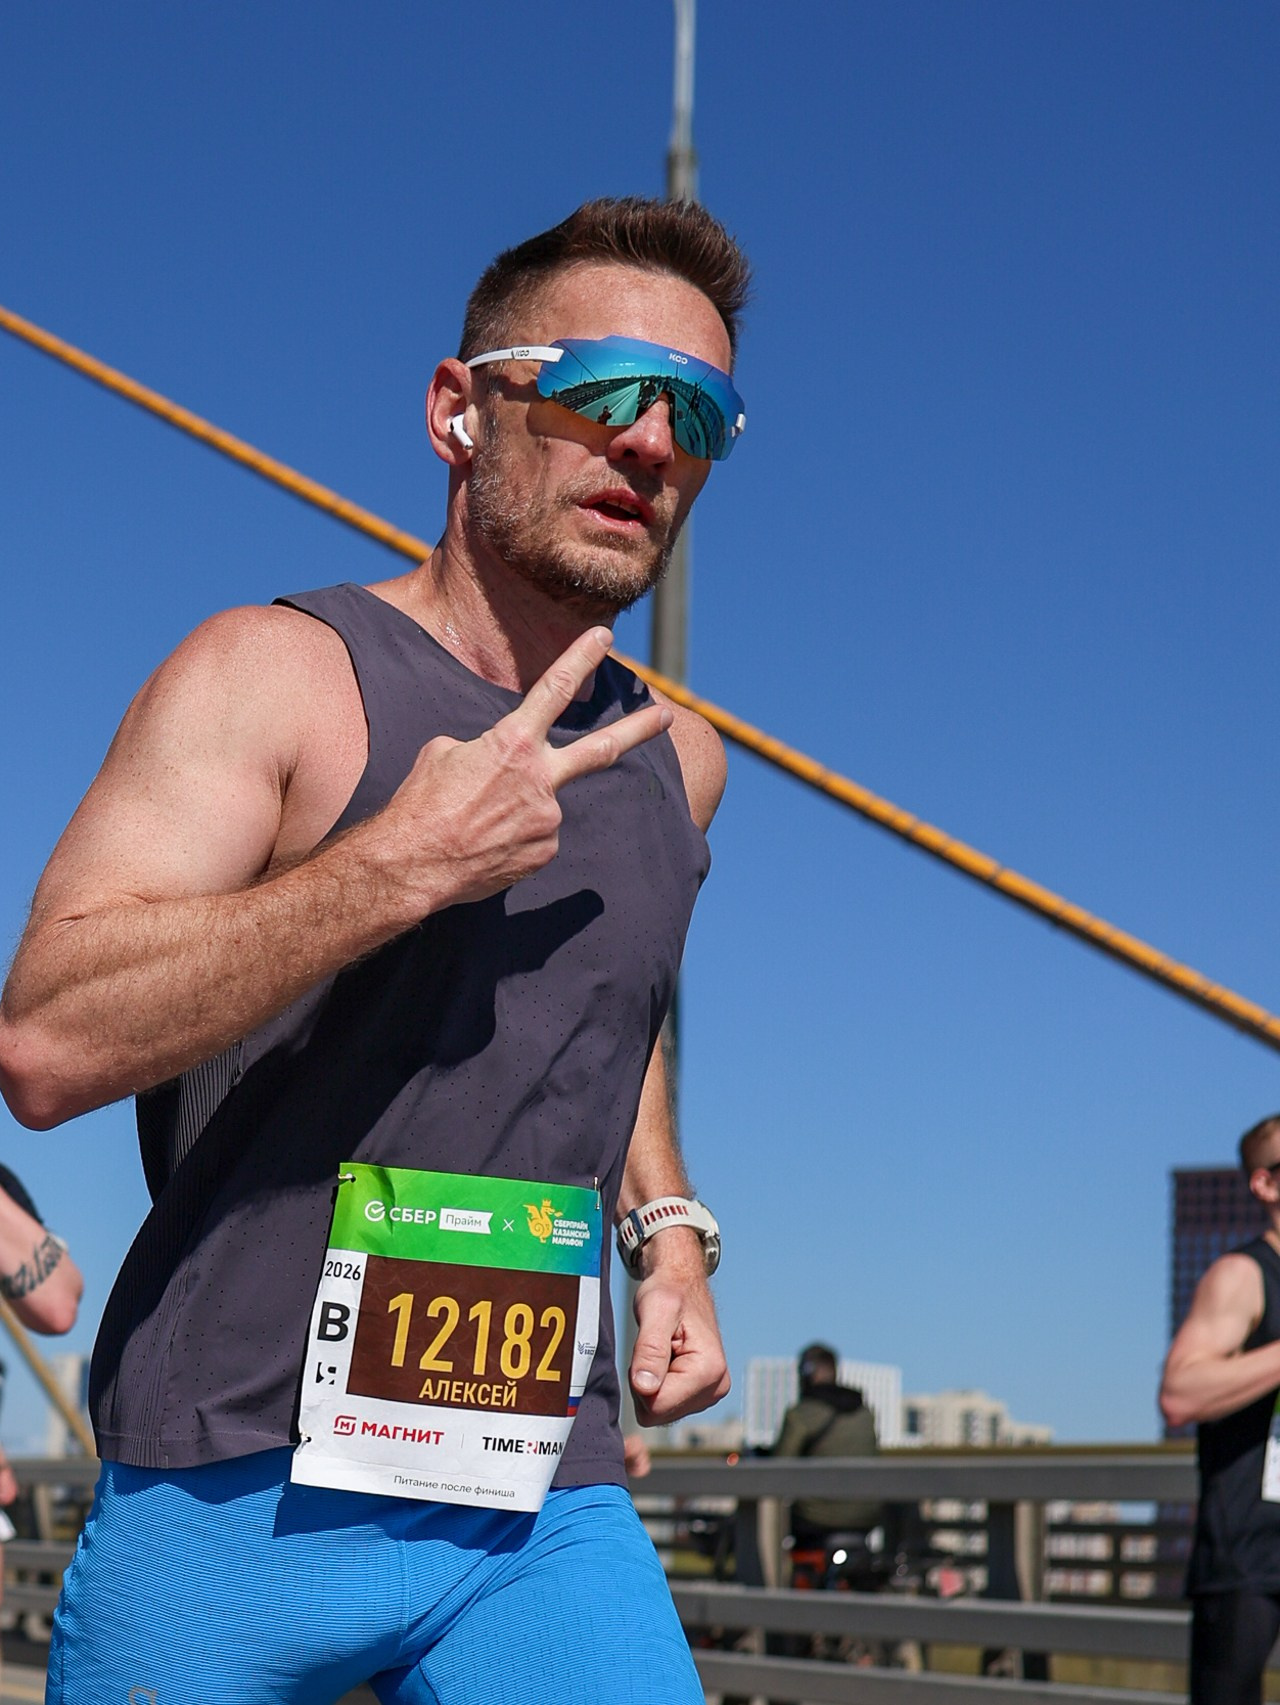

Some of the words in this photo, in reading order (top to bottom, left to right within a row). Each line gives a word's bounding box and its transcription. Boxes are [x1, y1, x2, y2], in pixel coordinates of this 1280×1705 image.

[668, 352, 688, 364] KOO
[389, 1207, 437, 1224] СБЕР
[445, 1214, 482, 1226] Прайм
[551, 1237, 584, 1248] МАРАФОН
[552, 1228, 590, 1240] КАЗАНСКИЙ
[324, 1260, 361, 1281] 2026
[387, 1292, 567, 1382] 12182
[419, 1378, 518, 1408] АЛЕКСЕЙ
[361, 1421, 445, 1446] МАГНИТ
[394, 1475, 439, 1489] Питание
[440, 1482, 472, 1493] после
[474, 1485, 515, 1498] финиша
